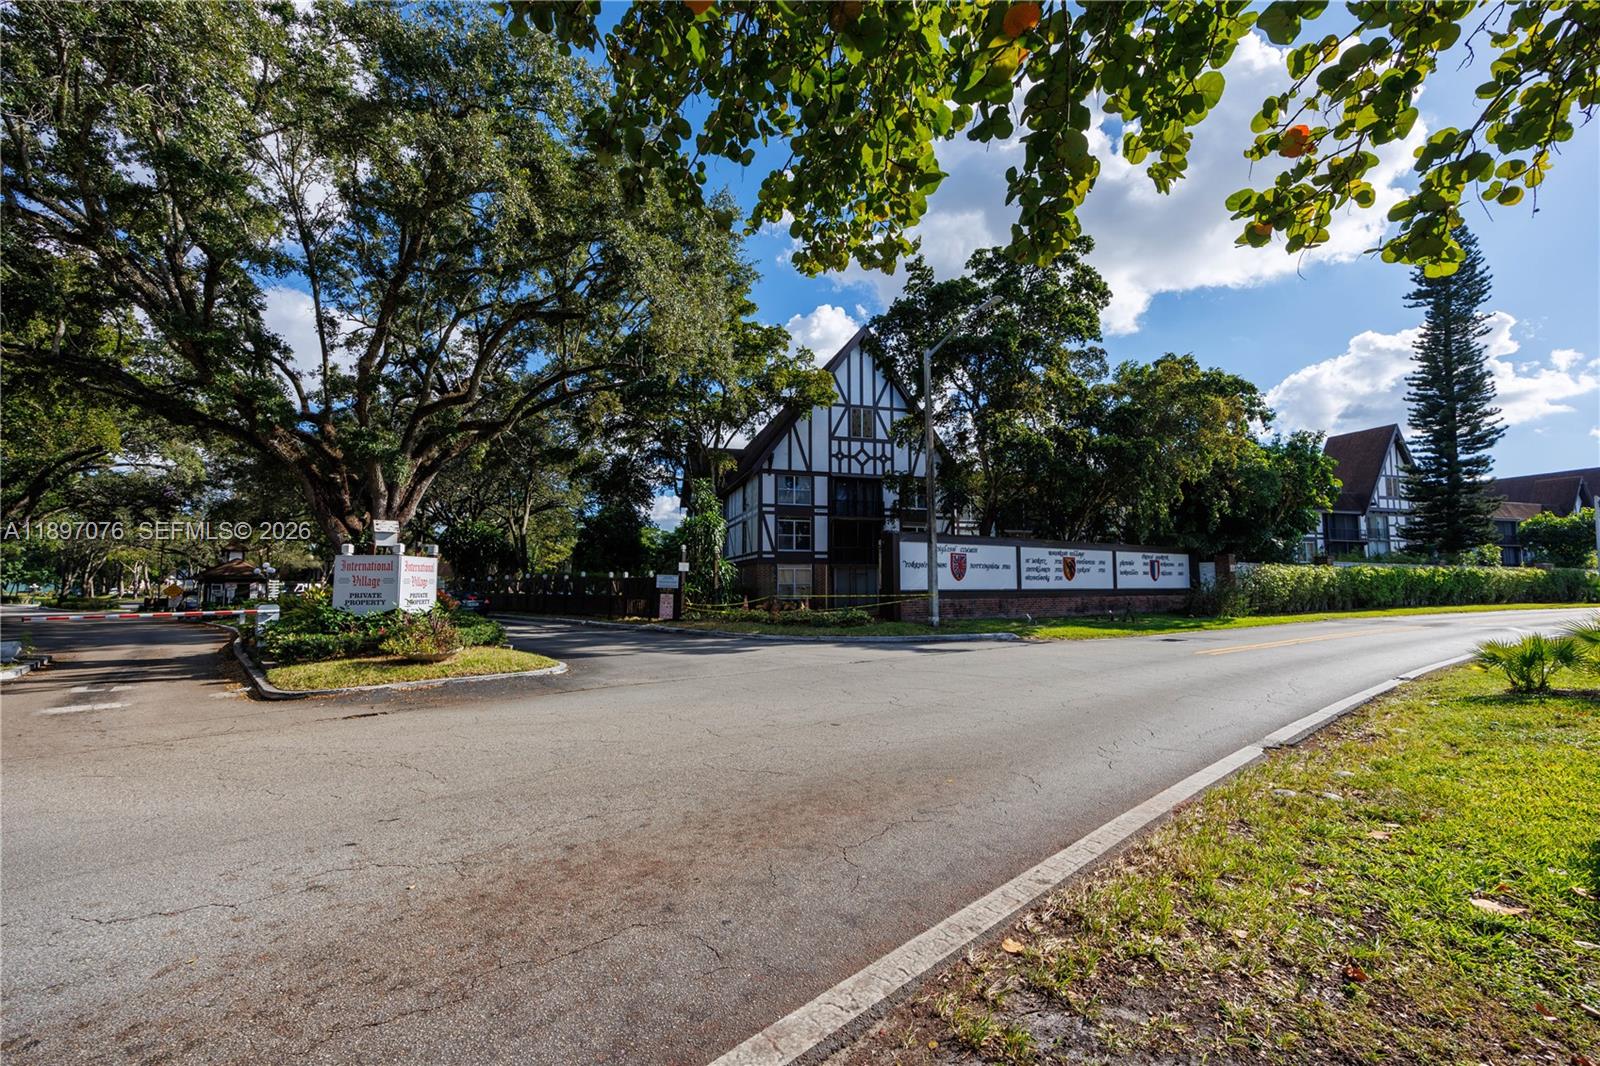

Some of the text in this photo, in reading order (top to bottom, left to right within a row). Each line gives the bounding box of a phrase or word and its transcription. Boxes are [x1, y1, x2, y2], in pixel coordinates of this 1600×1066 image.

[340, 560, 393, 571] International
[405, 560, 434, 572] International
[352, 575, 380, 588] Village
[411, 576, 428, 589] Village
